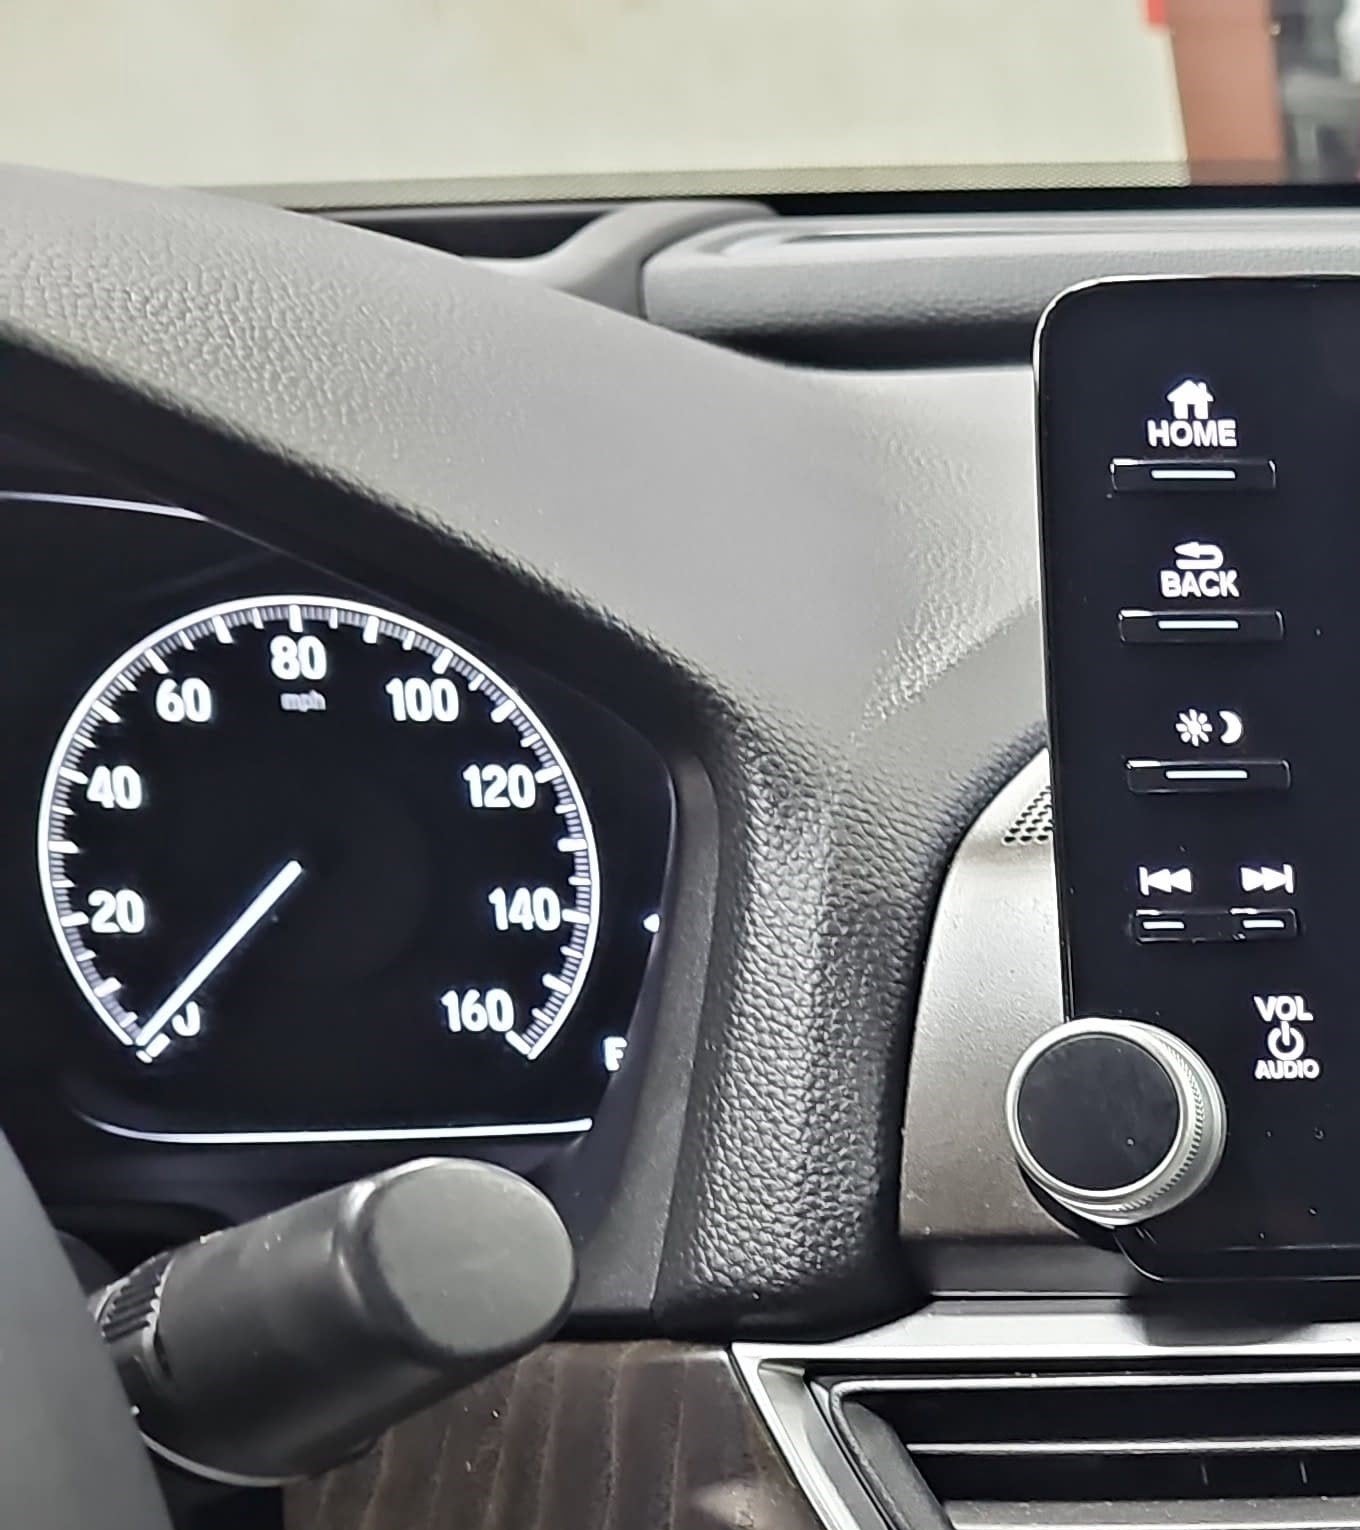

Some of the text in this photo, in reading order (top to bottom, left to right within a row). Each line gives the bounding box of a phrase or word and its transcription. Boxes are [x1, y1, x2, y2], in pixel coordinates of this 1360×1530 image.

[1147, 419, 1237, 447] HOME
[1160, 570, 1240, 598] BACK
[270, 634, 327, 680] 80
[155, 678, 212, 723] 60
[386, 678, 459, 723] 100
[86, 765, 142, 810] 40
[463, 763, 536, 808] 120
[87, 888, 145, 934] 20
[488, 887, 561, 932] 140
[441, 988, 514, 1033] 160
[1254, 996, 1313, 1022] VOL
[1254, 1059, 1320, 1080] AUDIO
